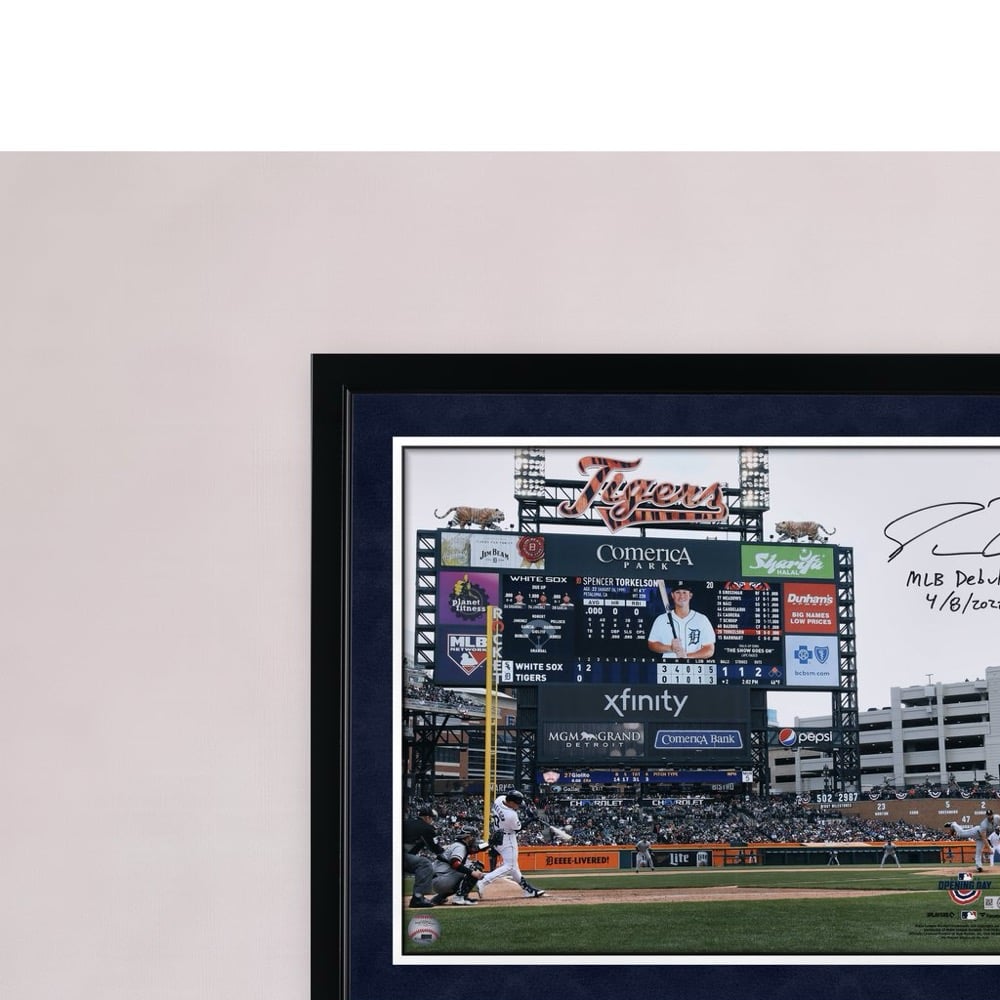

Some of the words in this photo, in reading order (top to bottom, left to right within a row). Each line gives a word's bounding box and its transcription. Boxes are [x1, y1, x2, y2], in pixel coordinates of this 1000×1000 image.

[559, 456, 728, 533] Tigers
[624, 562, 668, 570] PARK
[583, 577, 614, 586] SPENCER
[616, 578, 658, 587] TORKELSON
[906, 571, 944, 587] MLB
[452, 599, 480, 607] planet
[788, 594, 833, 604] Dunham's
[450, 637, 487, 648] MLB
[492, 608, 504, 684] ROCKET
[722, 667, 727, 676] 1
[739, 667, 744, 676] 1
[755, 667, 762, 677] 2
[604, 688, 688, 717] xfinity
[549, 732, 579, 741] MGM
[597, 732, 641, 741] GRAND
[711, 734, 735, 744] Bank
[799, 731, 832, 744] pepsi
[817, 794, 832, 802] 502
[839, 793, 858, 801] 2987
[670, 853, 689, 865] Lite
[938, 881, 974, 890] OPENING
[975, 881, 992, 889] DAY
